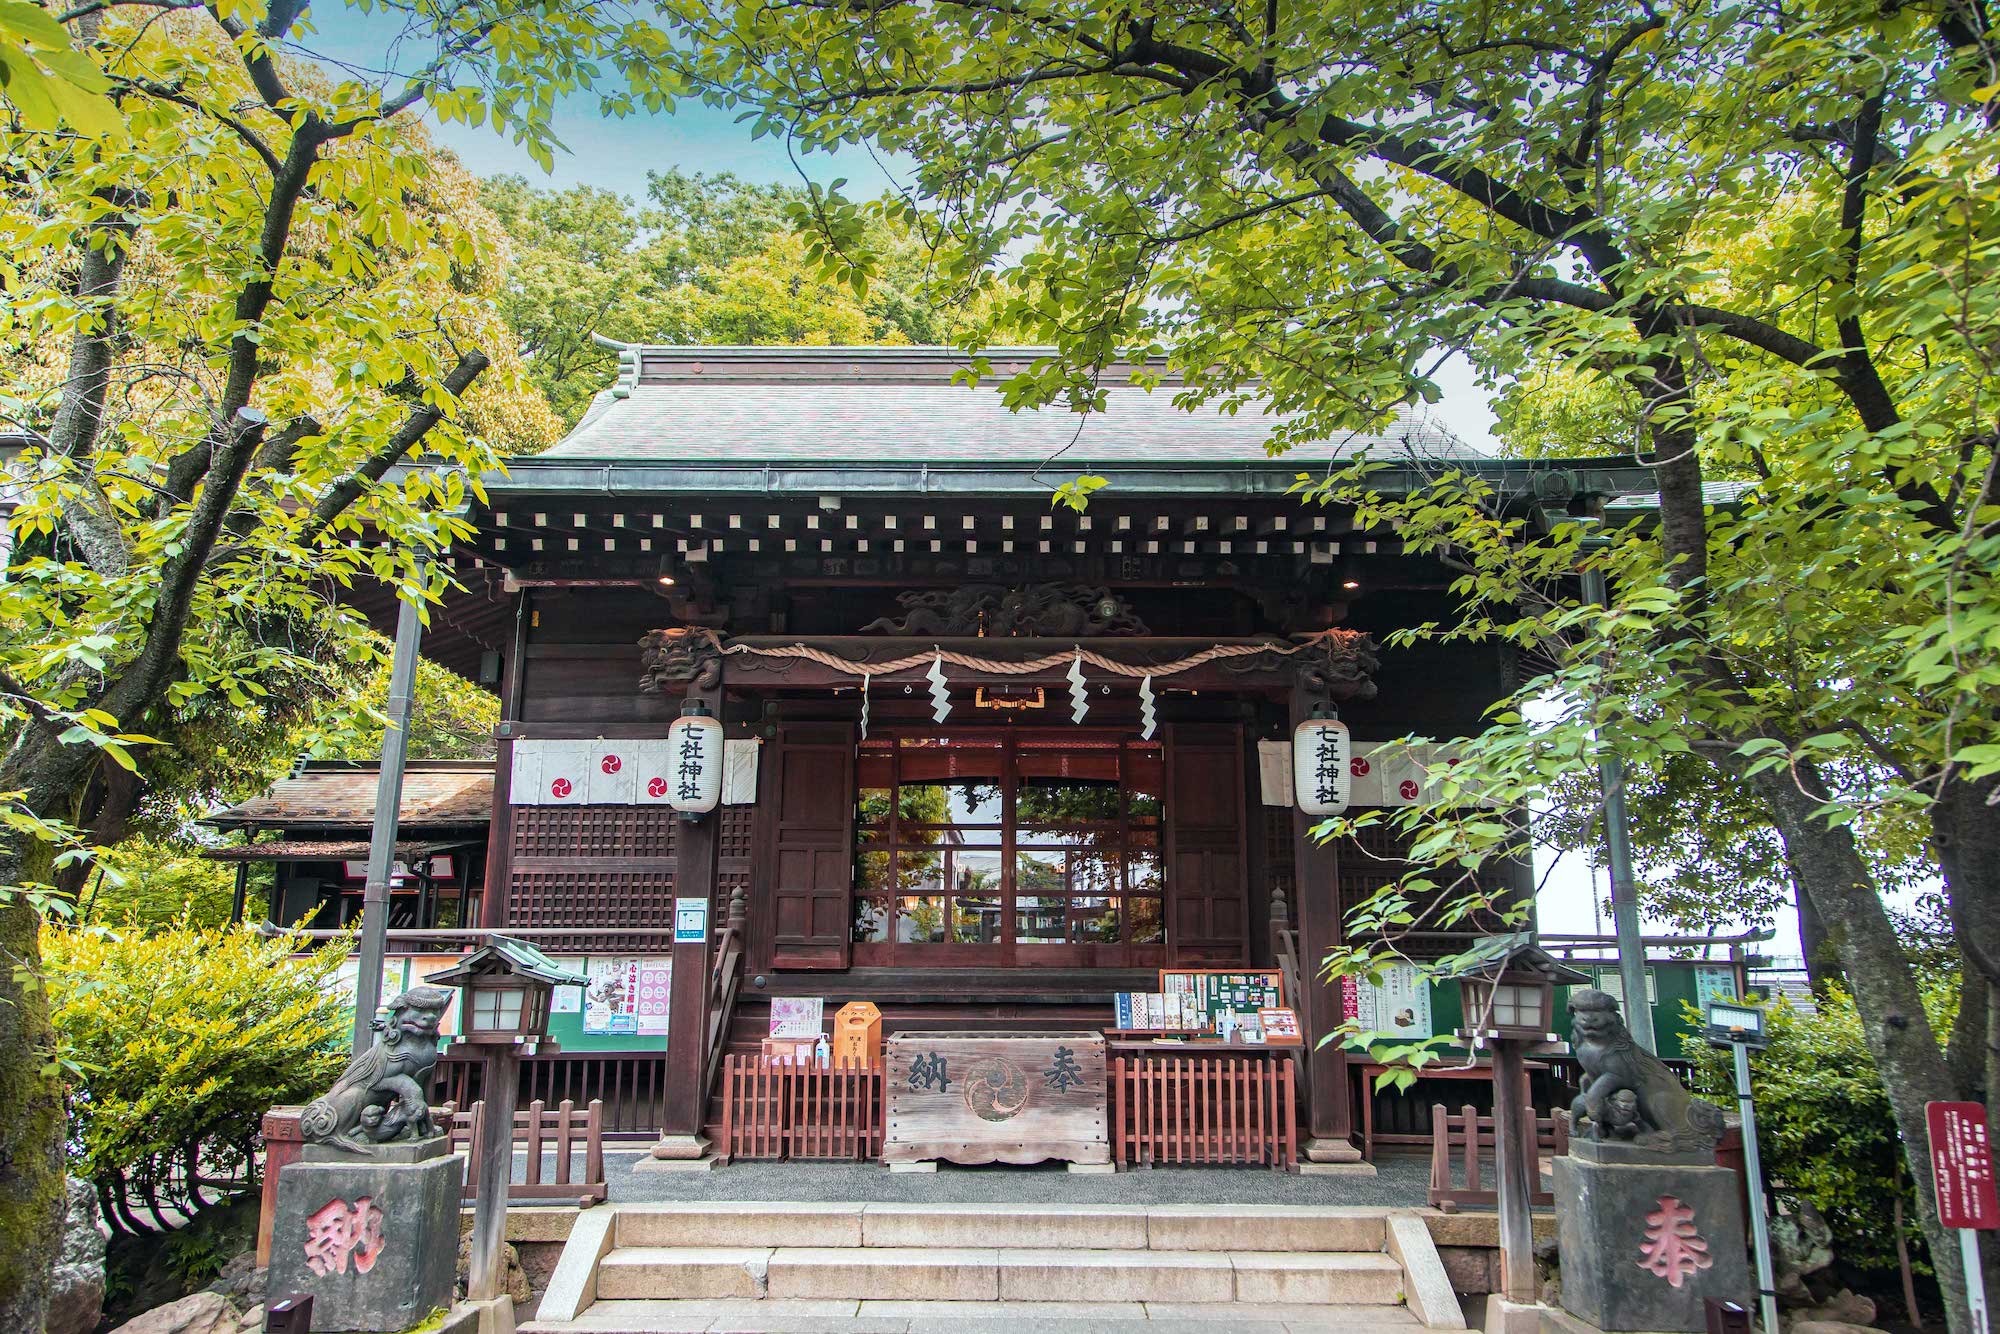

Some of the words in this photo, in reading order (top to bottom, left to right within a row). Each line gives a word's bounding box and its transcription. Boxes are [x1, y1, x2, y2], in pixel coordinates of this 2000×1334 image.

[677, 722, 705, 801] 七社神社
[1315, 725, 1341, 805] 七社神社
[908, 1051, 953, 1094] 納
[1044, 1045, 1085, 1094] 奉
[303, 1195, 386, 1279] 納
[1635, 1193, 1714, 1288] 奉
